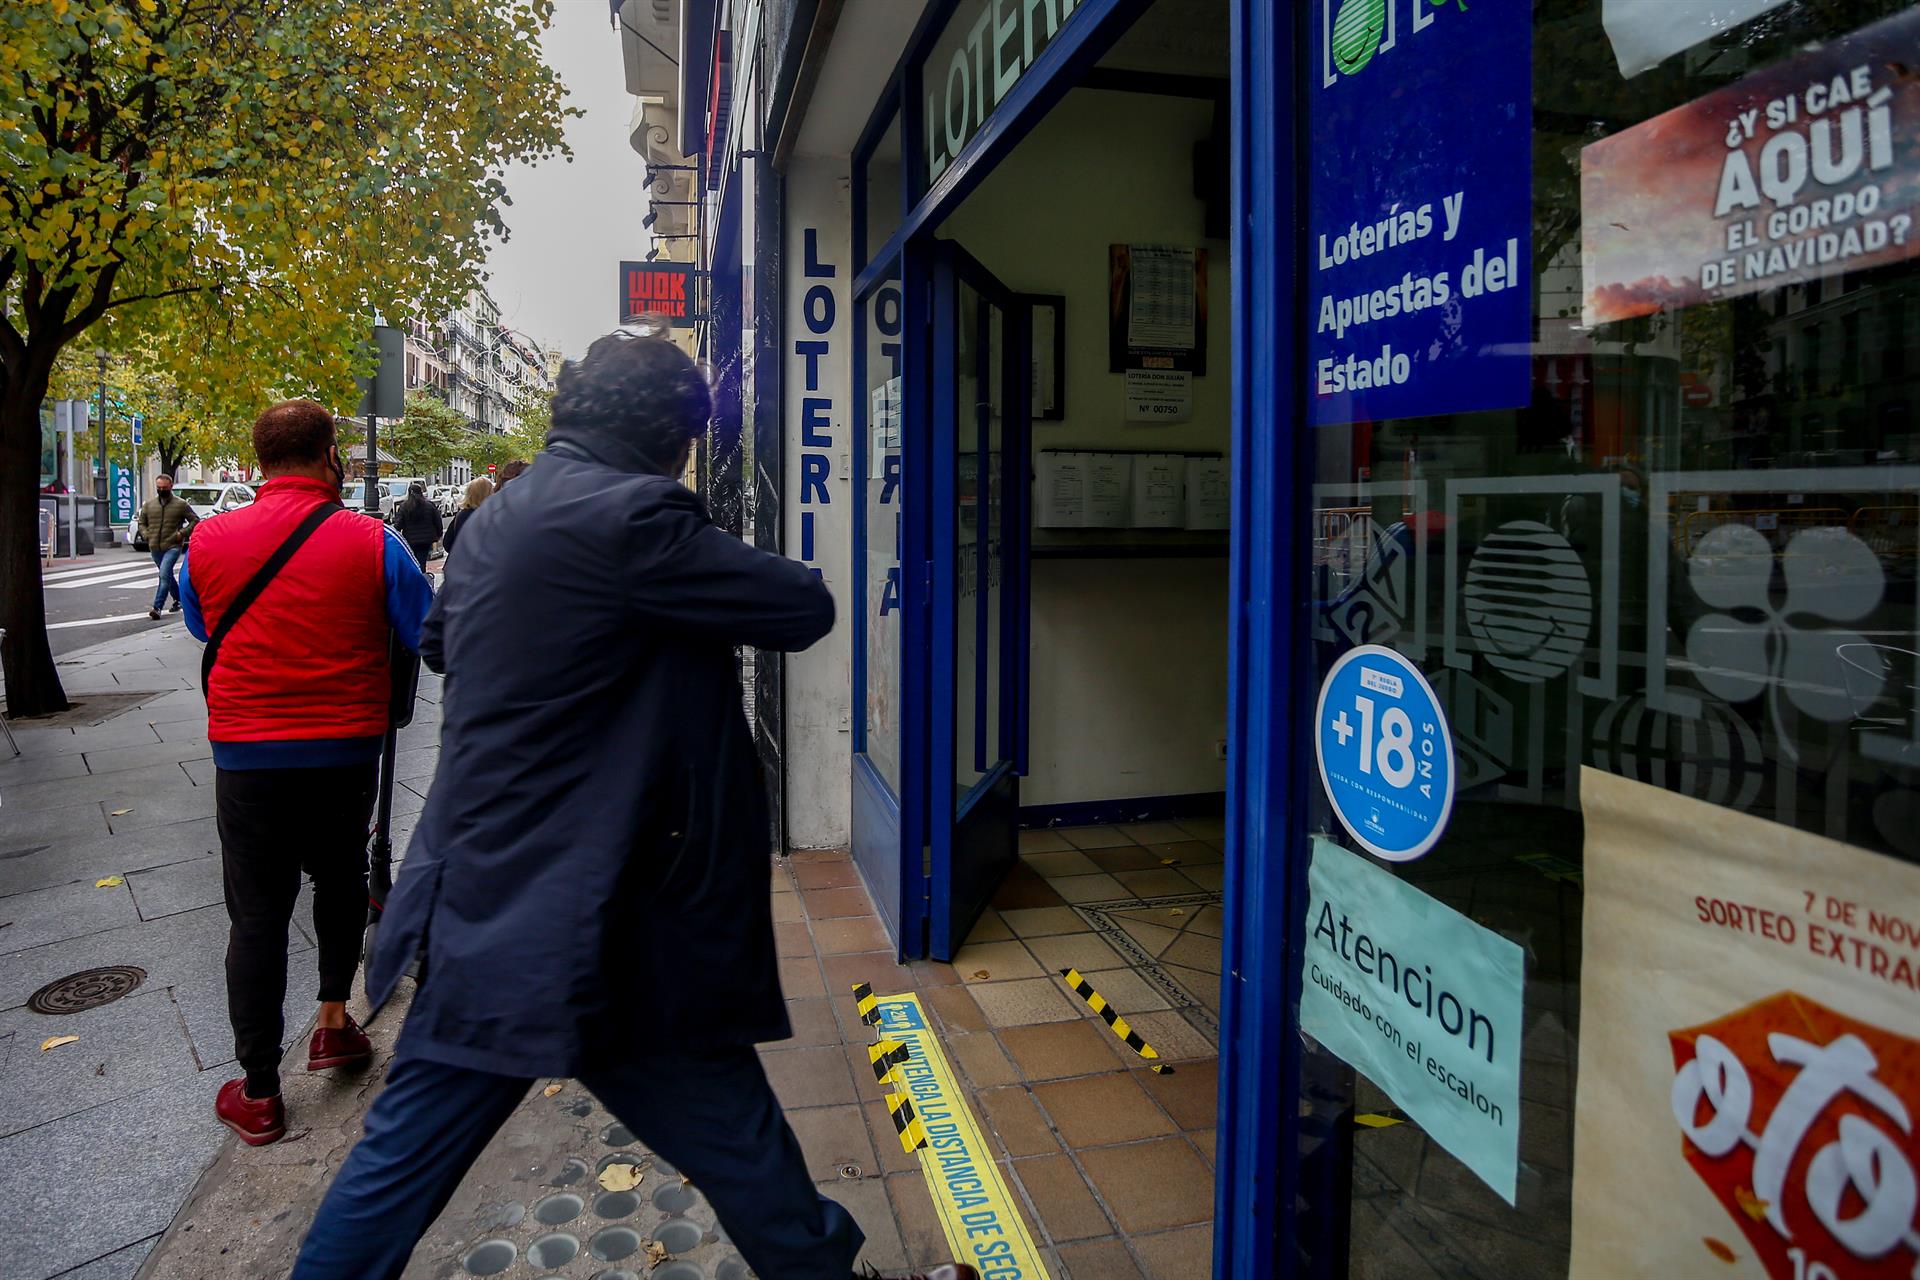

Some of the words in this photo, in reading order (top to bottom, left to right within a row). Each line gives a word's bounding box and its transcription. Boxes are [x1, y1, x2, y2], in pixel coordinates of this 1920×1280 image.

[1725, 108, 1759, 148] ¿Y
[1766, 94, 1797, 129] SI
[1805, 64, 1871, 115] CAE
[1714, 86, 1893, 217] AQUÍ
[1319, 203, 1432, 270] Loterías
[1443, 191, 1463, 241] y
[1702, 258, 1736, 289] DE
[1745, 214, 1911, 279] NAVIDAD?
[1727, 220, 1760, 250] EL
[1768, 185, 1880, 240] GORDO
[628, 271, 686, 300] WOK
[1317, 272, 1449, 339] Apuestas
[1461, 238, 1518, 298] del
[796, 228, 836, 579] LOTERI
[1318, 344, 1410, 394] Estado
[1153, 405, 1178, 414] 00750
[1332, 695, 1415, 789] +18
[1417, 722, 1434, 799] AÑOS
[1330, 770, 1348, 784] JUEGA
[1351, 780, 1364, 792] CON
[1366, 787, 1428, 822] RESPONSABILIDAD
[1695, 896, 1796, 944] SORTEO
[1808, 923, 1920, 991] EXTRA
[1803, 890, 1815, 913] 7
[1826, 897, 1857, 927] DE
[1314, 901, 1494, 1063] Atencion
[1311, 964, 1371, 1020] Cuidado
[1376, 1014, 1401, 1048] con
[1406, 1041, 1421, 1064] el
[1426, 1056, 1503, 1126] escalon
[918, 1103, 953, 1123] LA
[926, 1123, 989, 1209] DISTANCIA
[961, 1210, 1004, 1239] DE
